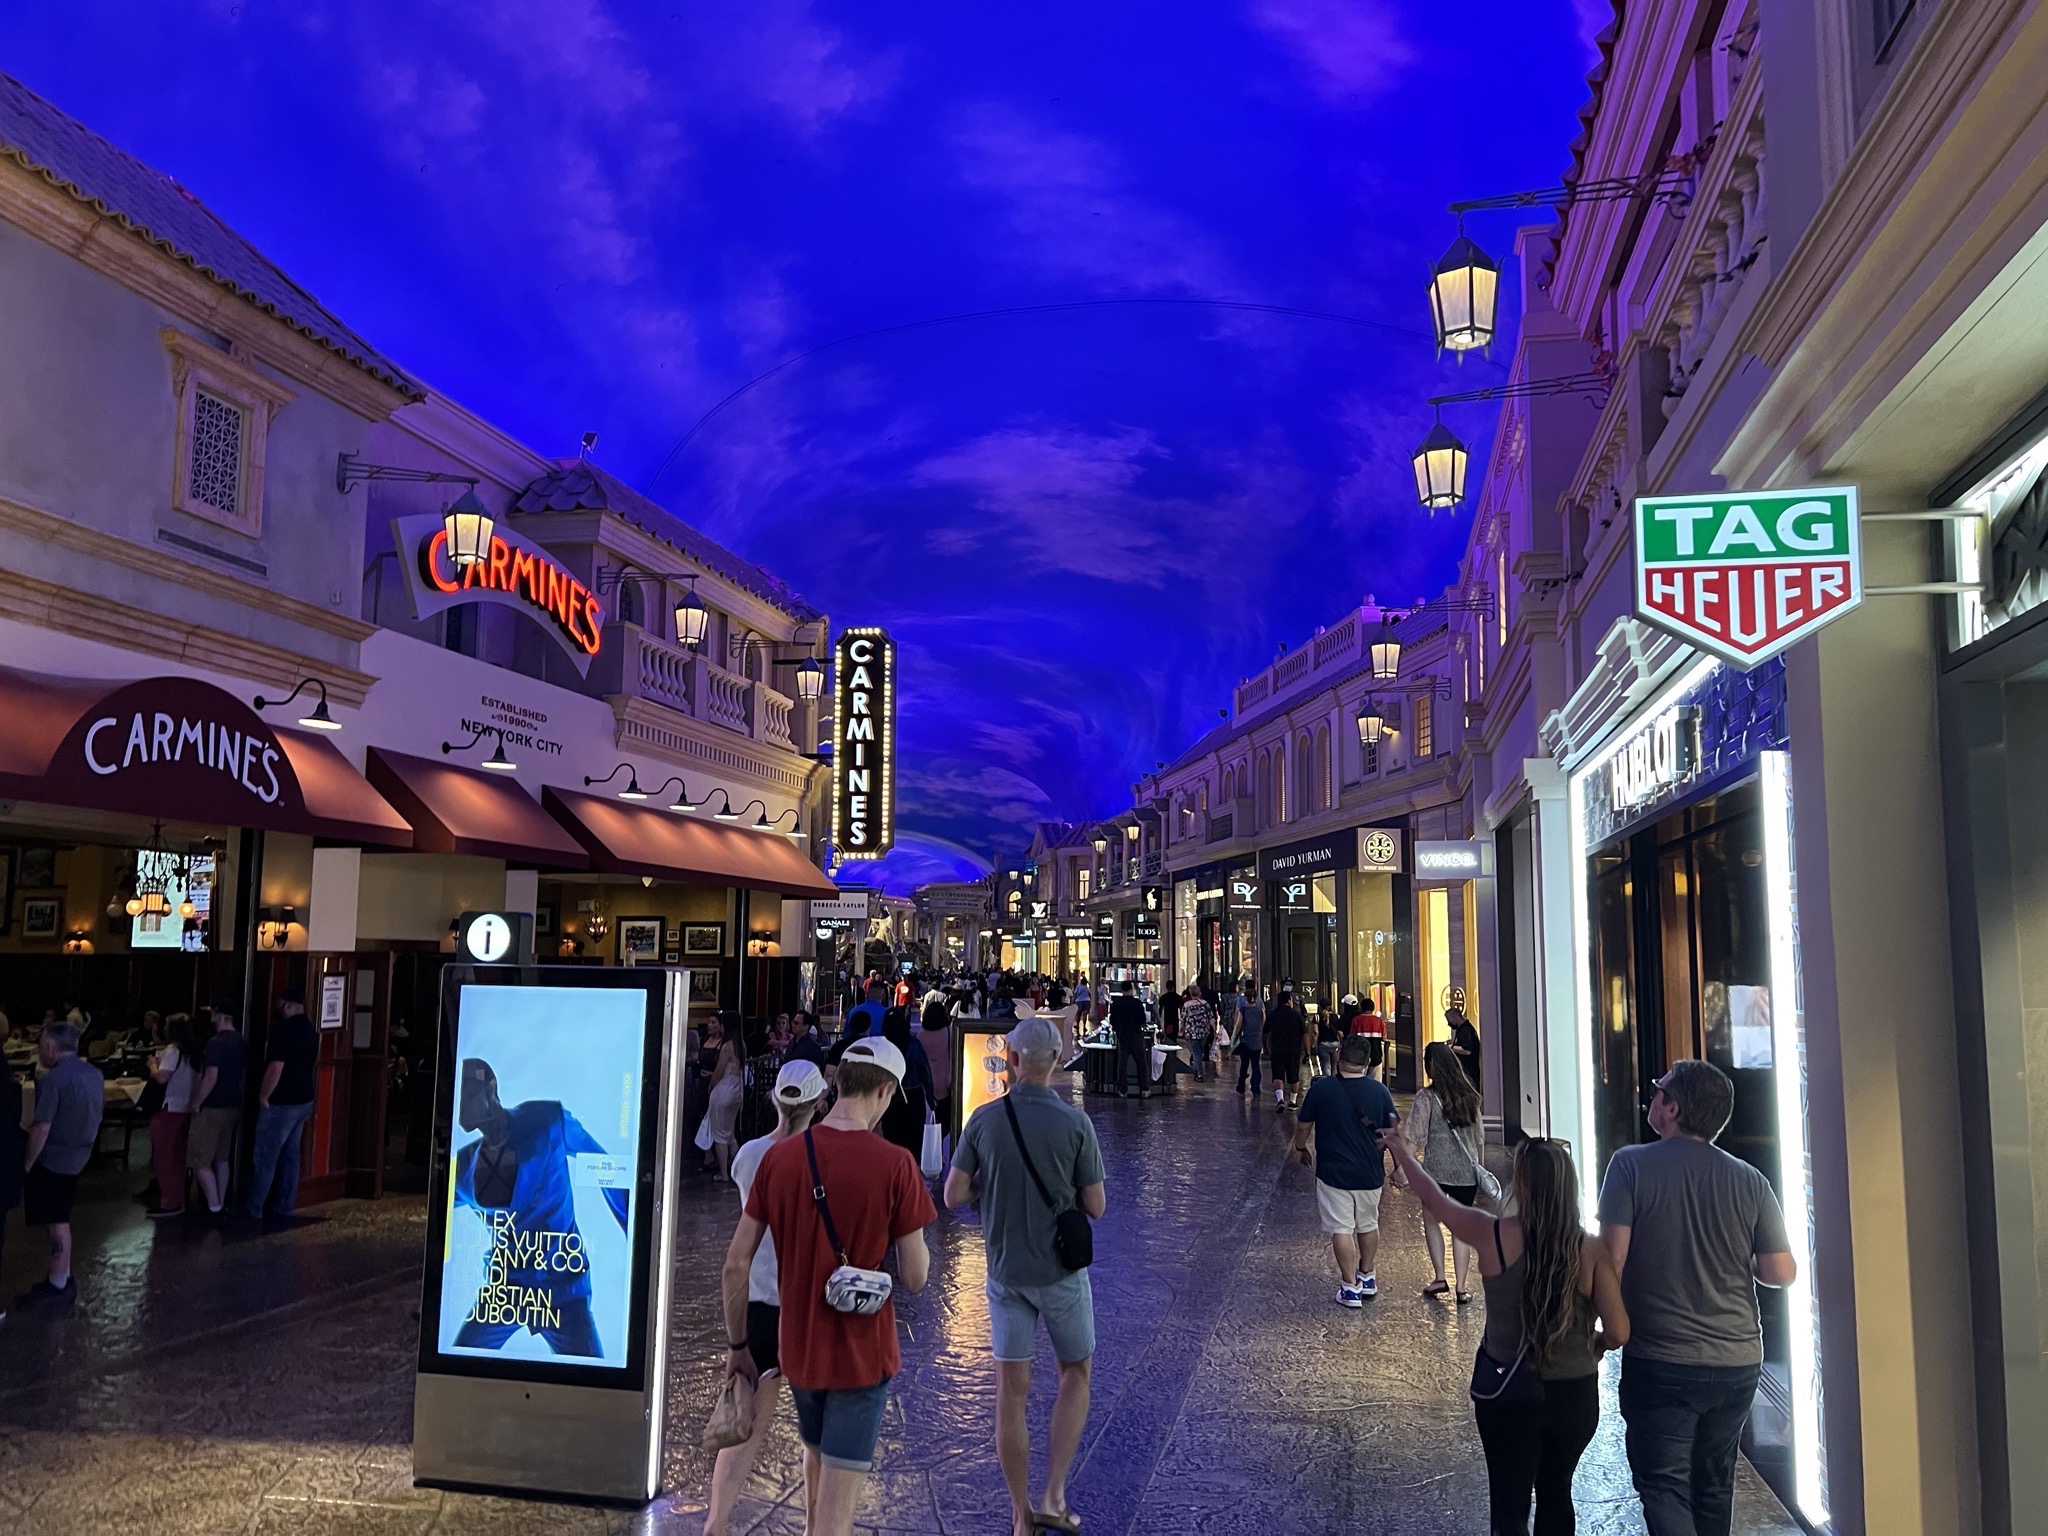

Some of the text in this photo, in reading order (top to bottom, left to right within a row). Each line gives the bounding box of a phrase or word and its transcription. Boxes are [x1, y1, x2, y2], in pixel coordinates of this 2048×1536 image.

[1654, 501, 1834, 555] TAG
[1651, 566, 1844, 647] HEUER
[481, 695, 548, 723] ESTABLISHED
[504, 714, 527, 729] 1990
[461, 718, 564, 756] NEW YORK CITY
[846, 639, 874, 845] CARMINES
[84, 712, 280, 803] CARMINE'S
[1611, 705, 1684, 811] HUBLOT
[1272, 848, 1332, 871] DAVID YURMAN
[458, 1208, 516, 1230] OLEX
[534, 1250, 547, 1271] &
[551, 1251, 586, 1273] CO.
[453, 1284, 552, 1308] RISTIAN
[455, 1302, 560, 1329] OUBOUTIN
